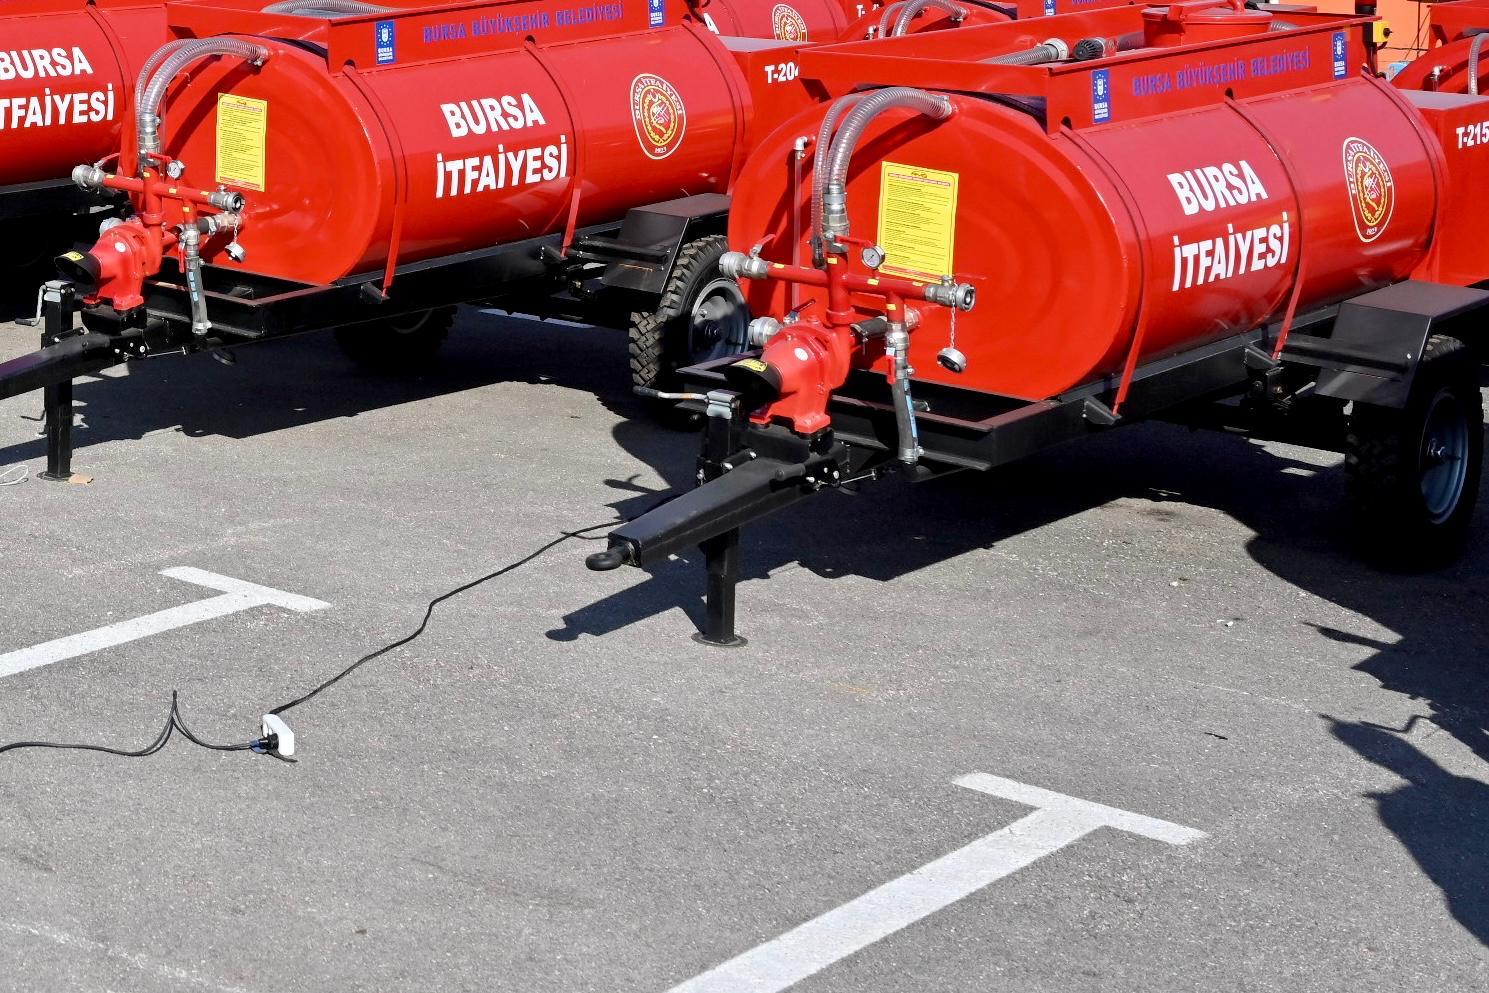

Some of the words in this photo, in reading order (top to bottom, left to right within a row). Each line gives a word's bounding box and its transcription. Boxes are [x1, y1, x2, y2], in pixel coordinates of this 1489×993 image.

[423, 23, 467, 43] BURSA
[472, 13, 550, 36] BÜYÜKŞEHİR
[556, 1, 624, 26] BELEDİYESİ
[1132, 73, 1172, 96] BURSA
[1177, 59, 1247, 88] BÜYÜKŞEHİR
[1251, 47, 1311, 75] BELEDİYESİ
[440, 93, 546, 137] BURSA
[1456, 121, 1489, 149] T-215
[436, 134, 568, 198] İTFAİYESİ
[1167, 160, 1268, 215] BURSA
[1172, 211, 1290, 291] İTFAİYESİ
